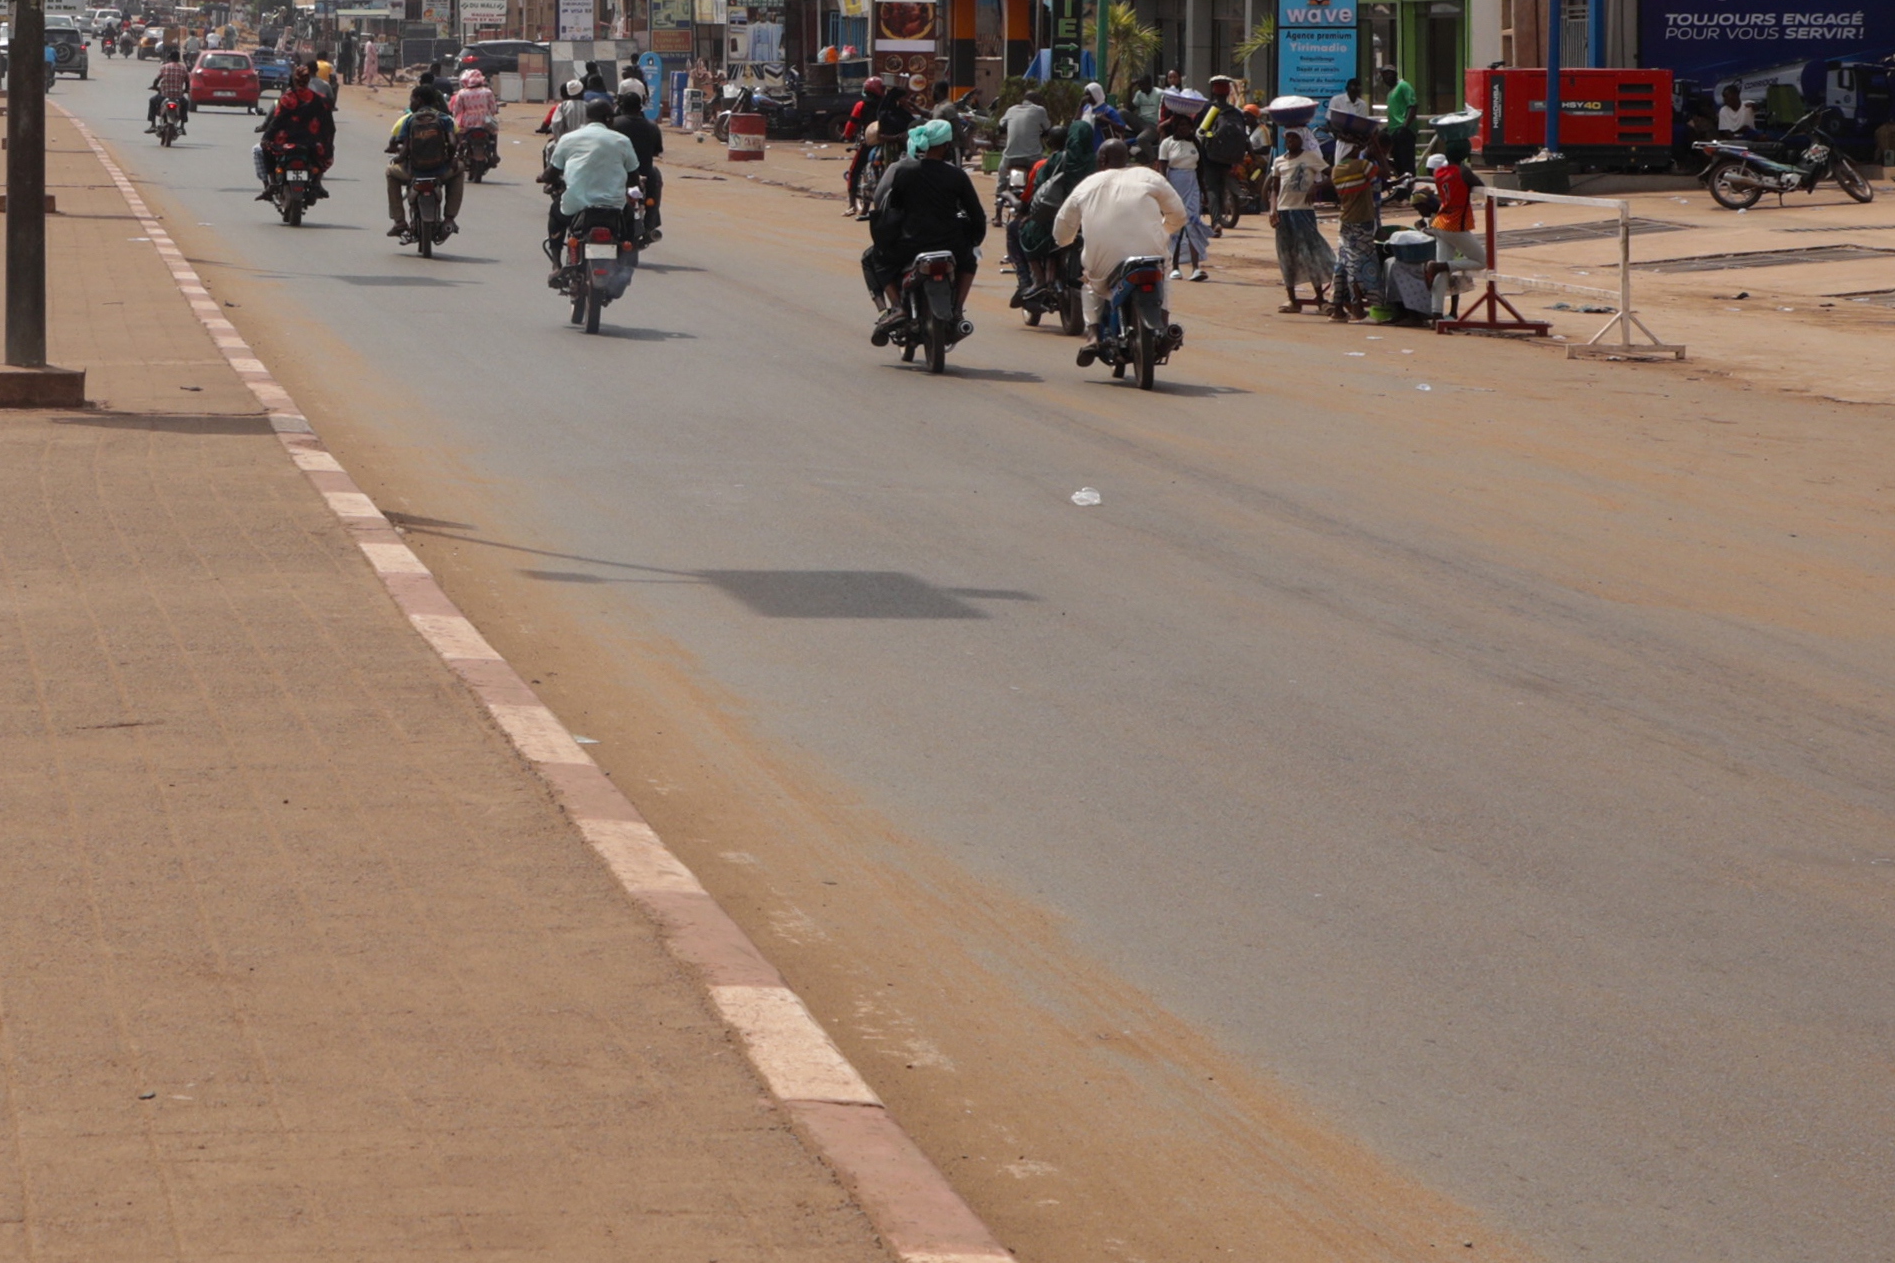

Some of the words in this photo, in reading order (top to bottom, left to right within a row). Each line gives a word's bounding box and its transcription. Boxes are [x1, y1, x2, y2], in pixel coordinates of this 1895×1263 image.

[1286, 7, 1353, 24] wave
[1664, 13, 1776, 26] TOUJOURS
[1782, 9, 1864, 26] ENGAGÉ
[1286, 31, 1315, 41] Agence
[1316, 32, 1352, 41] premium
[1665, 27, 1720, 40] POUR
[1726, 27, 1780, 40] VOUS
[1289, 42, 1348, 52] Yirimadio
